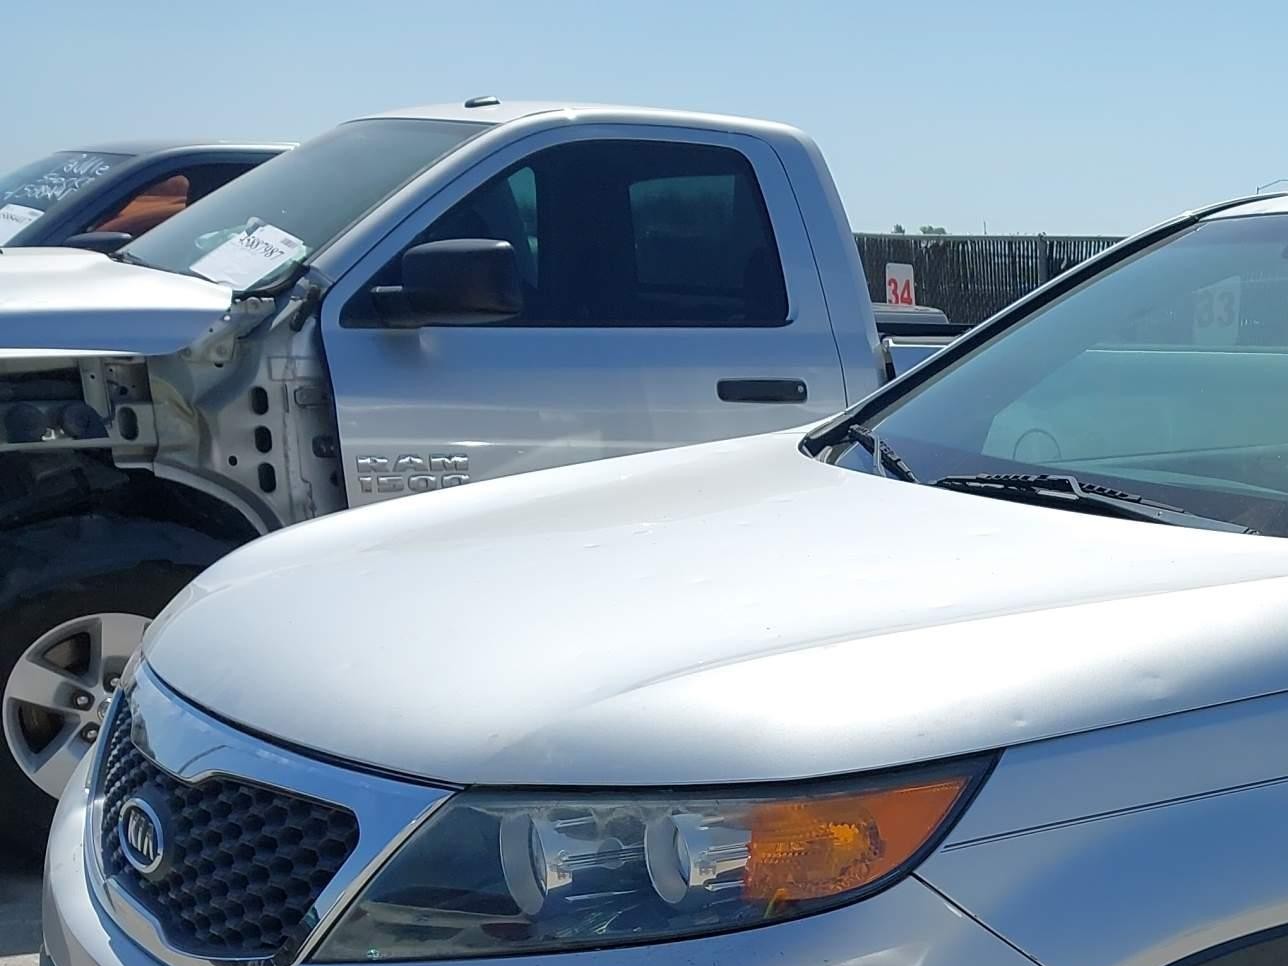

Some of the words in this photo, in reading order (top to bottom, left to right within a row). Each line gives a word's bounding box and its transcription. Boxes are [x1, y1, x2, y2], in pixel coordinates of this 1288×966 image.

[888, 278, 913, 305] 34
[356, 453, 469, 473] RAM
[357, 474, 470, 493] 1500
